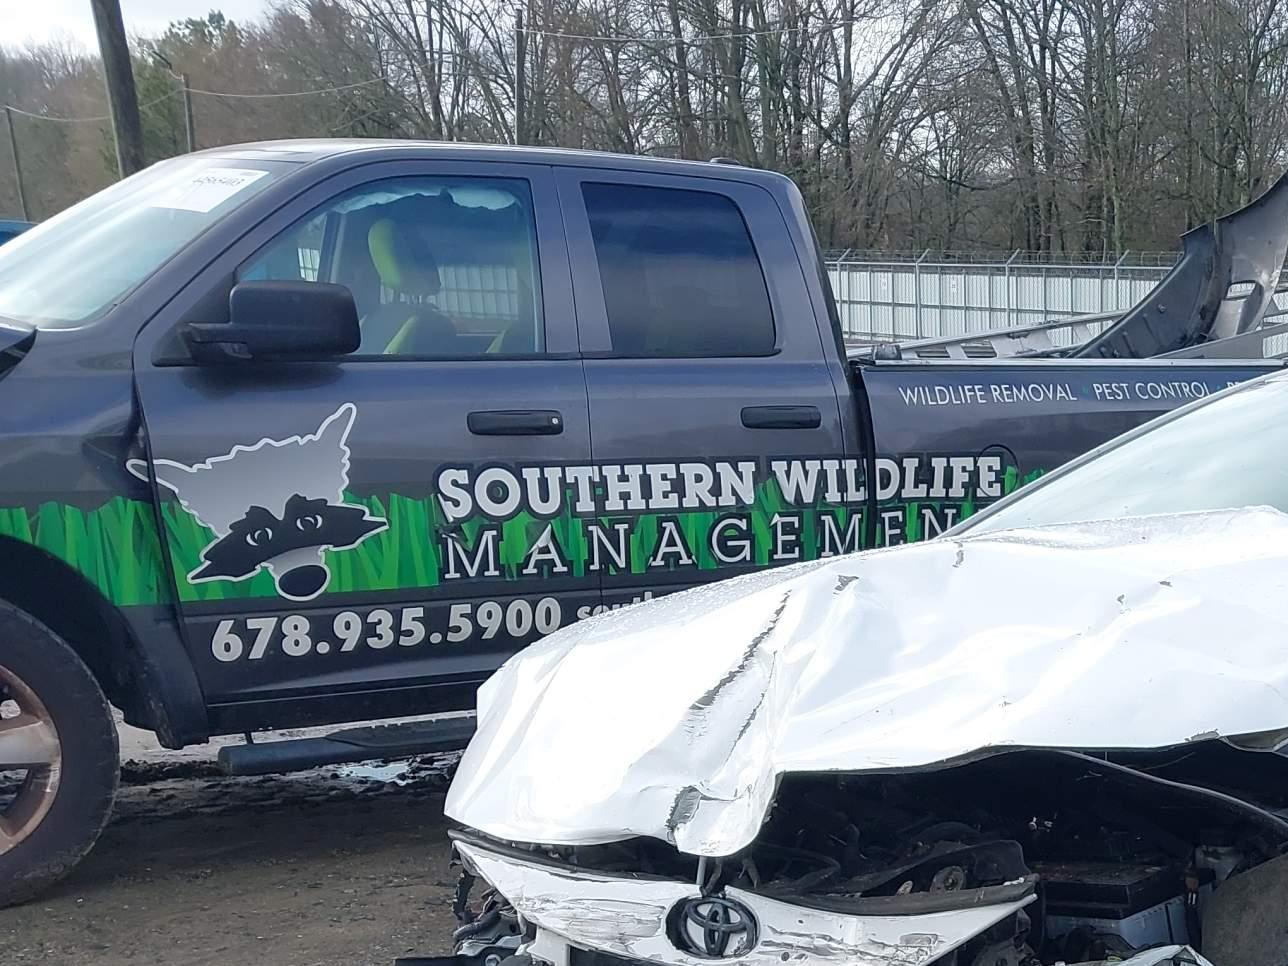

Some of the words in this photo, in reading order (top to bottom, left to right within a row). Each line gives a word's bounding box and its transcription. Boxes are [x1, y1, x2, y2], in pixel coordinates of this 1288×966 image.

[898, 384, 986, 406] WILDLIFE
[991, 383, 1078, 403] REMOVAL
[1094, 382, 1131, 401] PEST
[438, 461, 757, 519] SOUTHERN
[771, 456, 1001, 504] WILDLIFE
[443, 508, 984, 579] MANAGEMEN
[212, 597, 562, 662] 678.935.5900
